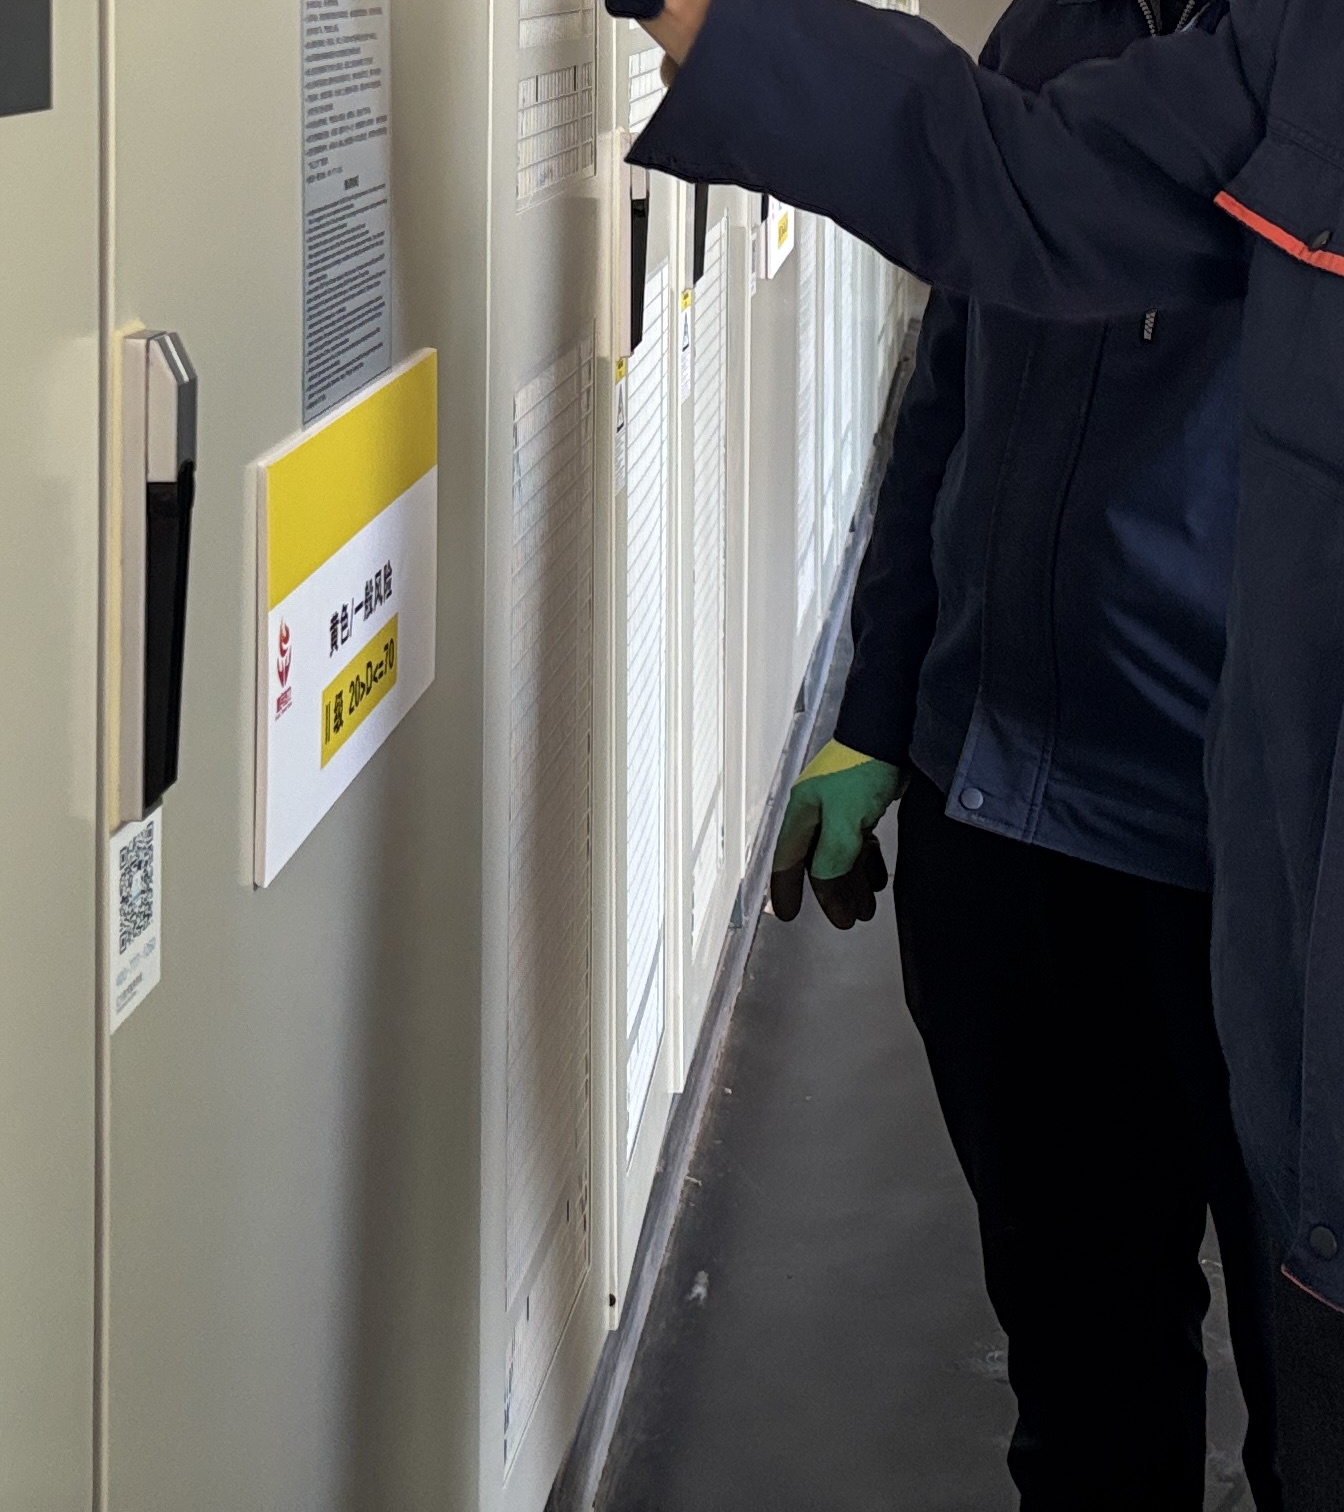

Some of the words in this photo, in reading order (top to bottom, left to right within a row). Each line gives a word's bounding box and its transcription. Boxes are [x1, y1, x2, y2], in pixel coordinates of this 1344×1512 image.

[329, 559, 393, 658] 黄色/一般风险
